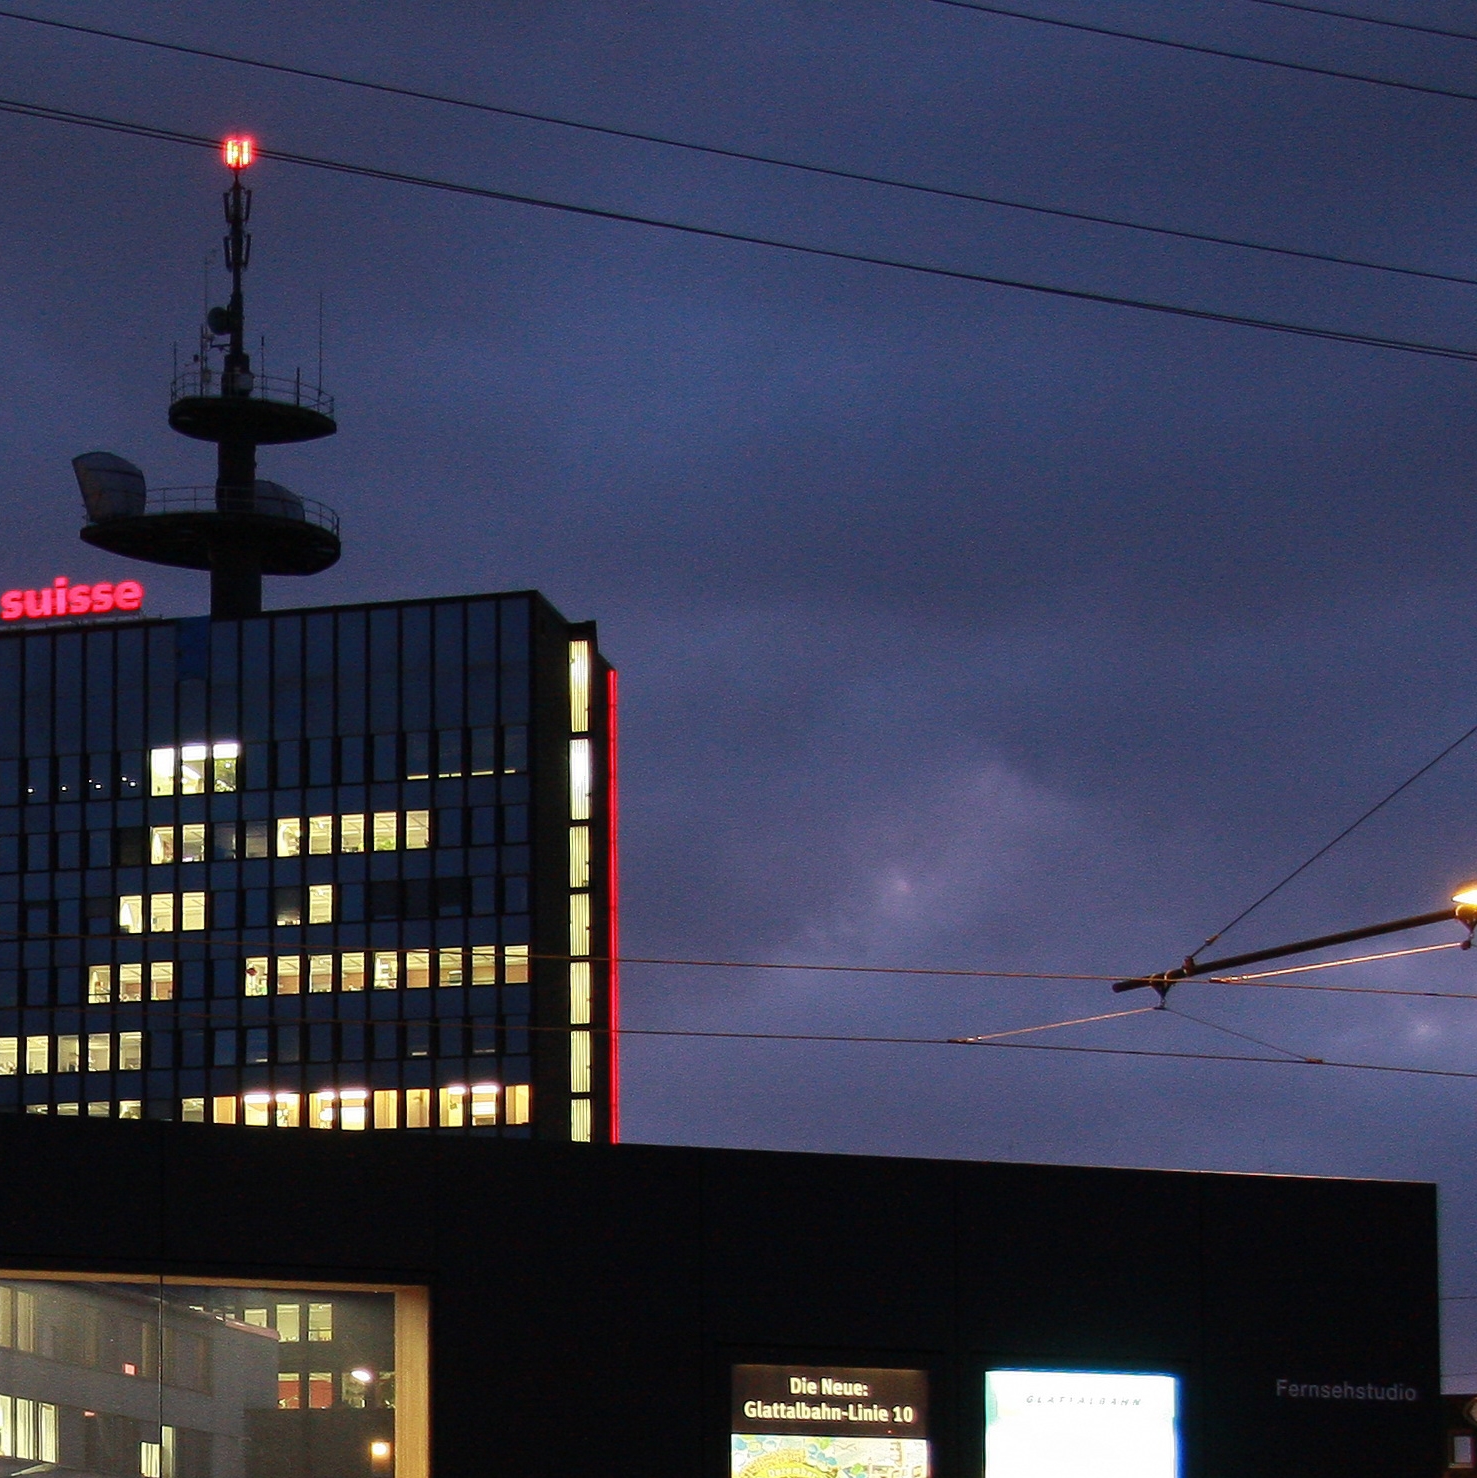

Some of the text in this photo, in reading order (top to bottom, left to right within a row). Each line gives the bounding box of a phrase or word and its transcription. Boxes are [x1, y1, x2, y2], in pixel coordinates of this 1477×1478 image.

[0, 577, 144, 621] suisse
[789, 1376, 869, 1398] Die Neue:
[1275, 1379, 1417, 1402] Fernsehstudio
[743, 1400, 913, 1424] Glattalbahn-Linie 10
